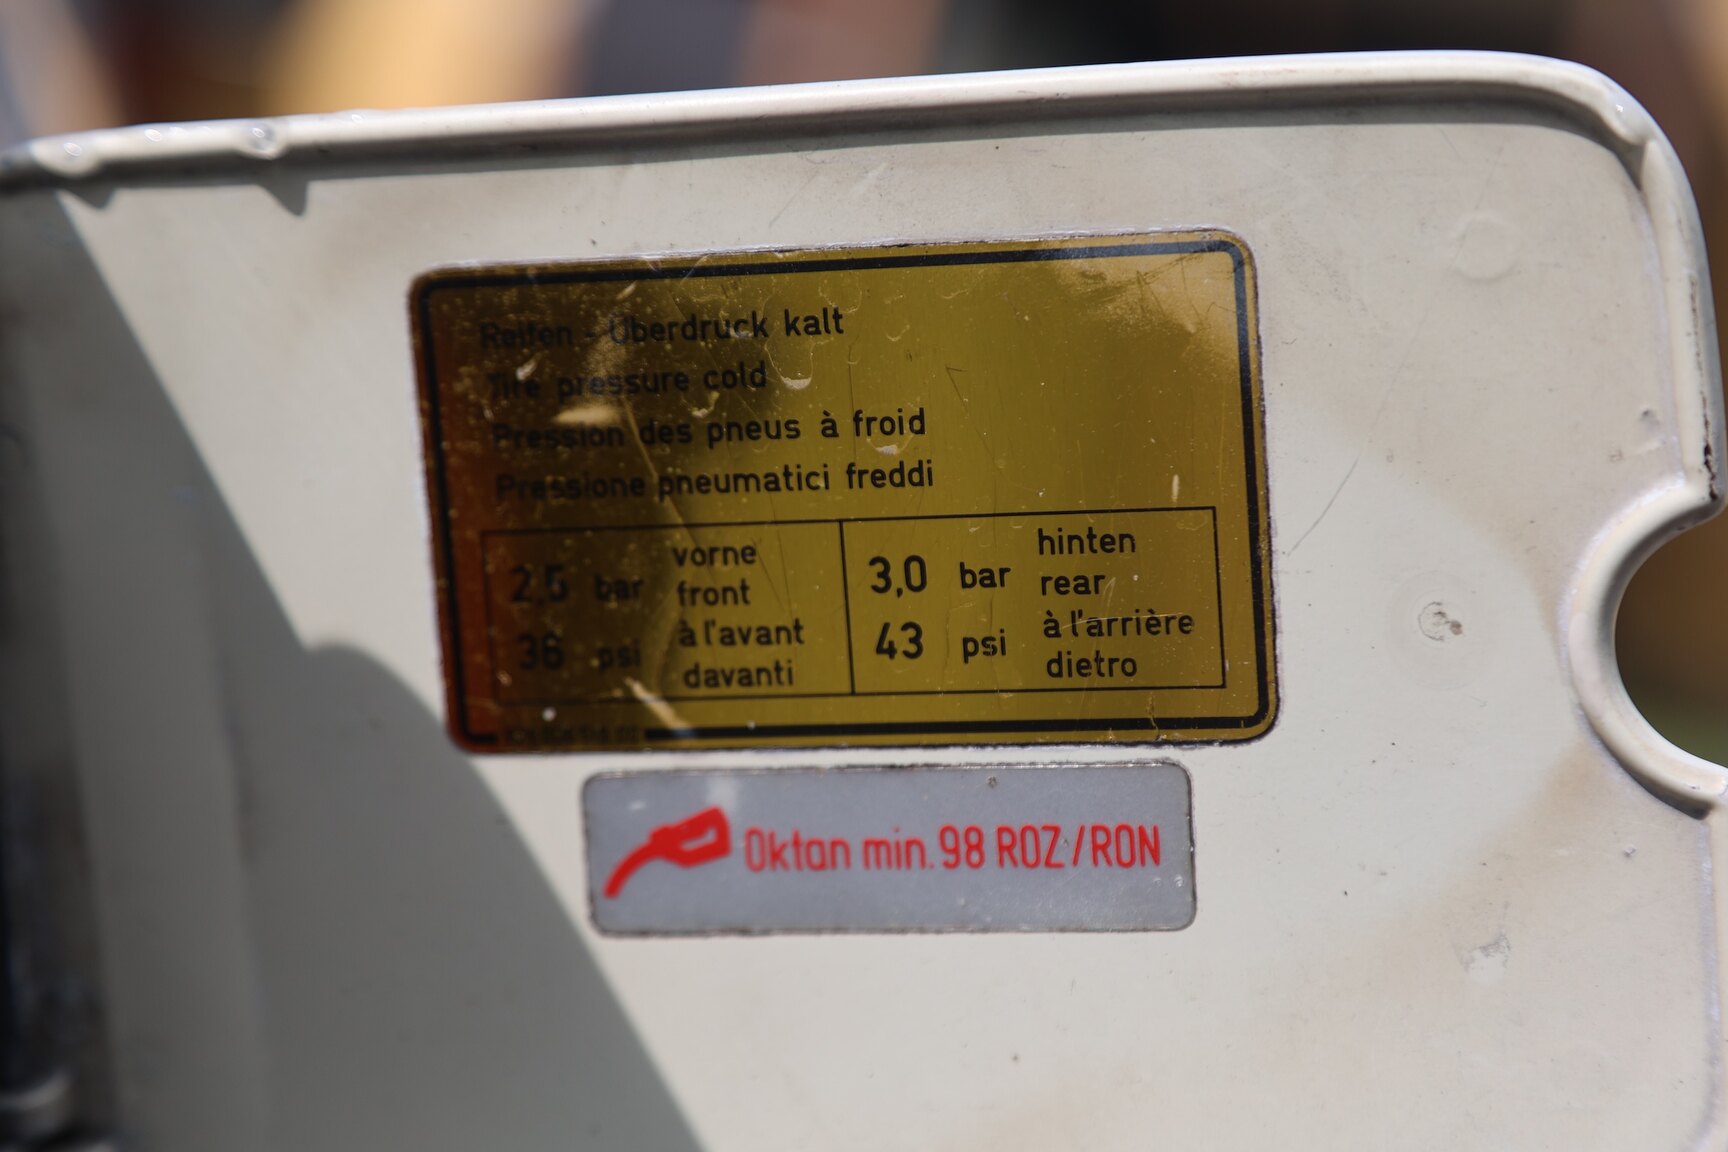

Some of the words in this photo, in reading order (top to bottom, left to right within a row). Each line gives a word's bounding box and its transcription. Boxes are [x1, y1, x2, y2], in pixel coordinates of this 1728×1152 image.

[480, 321, 573, 349] Reifen
[785, 307, 844, 337] kalt
[557, 370, 690, 405] pressure
[704, 361, 767, 390] cold
[493, 417, 625, 450] Pression
[639, 416, 692, 447] des
[707, 417, 801, 449] pneus
[821, 411, 839, 438] à
[853, 407, 926, 437] froid
[496, 470, 646, 502] Pressione
[659, 463, 830, 503] pneumatici
[846, 460, 934, 489] freddi
[672, 544, 757, 567] vorne
[1038, 527, 1137, 556] hinten
[593, 572, 645, 602] bar
[868, 554, 928, 599] 3,0
[960, 561, 1012, 590] bar
[1040, 574, 1106, 597] rear
[677, 579, 751, 607] front
[678, 620, 697, 648] à
[705, 618, 805, 646] l'avant
[1043, 610, 1063, 639] à
[1071, 609, 1195, 638] l'arrière
[516, 632, 566, 671] 36
[597, 641, 642, 672] psi
[875, 621, 925, 660] 43
[962, 628, 1008, 664] psi
[683, 662, 795, 690] davanti
[1046, 651, 1138, 678] dietro
[744, 826, 851, 872] Oktan
